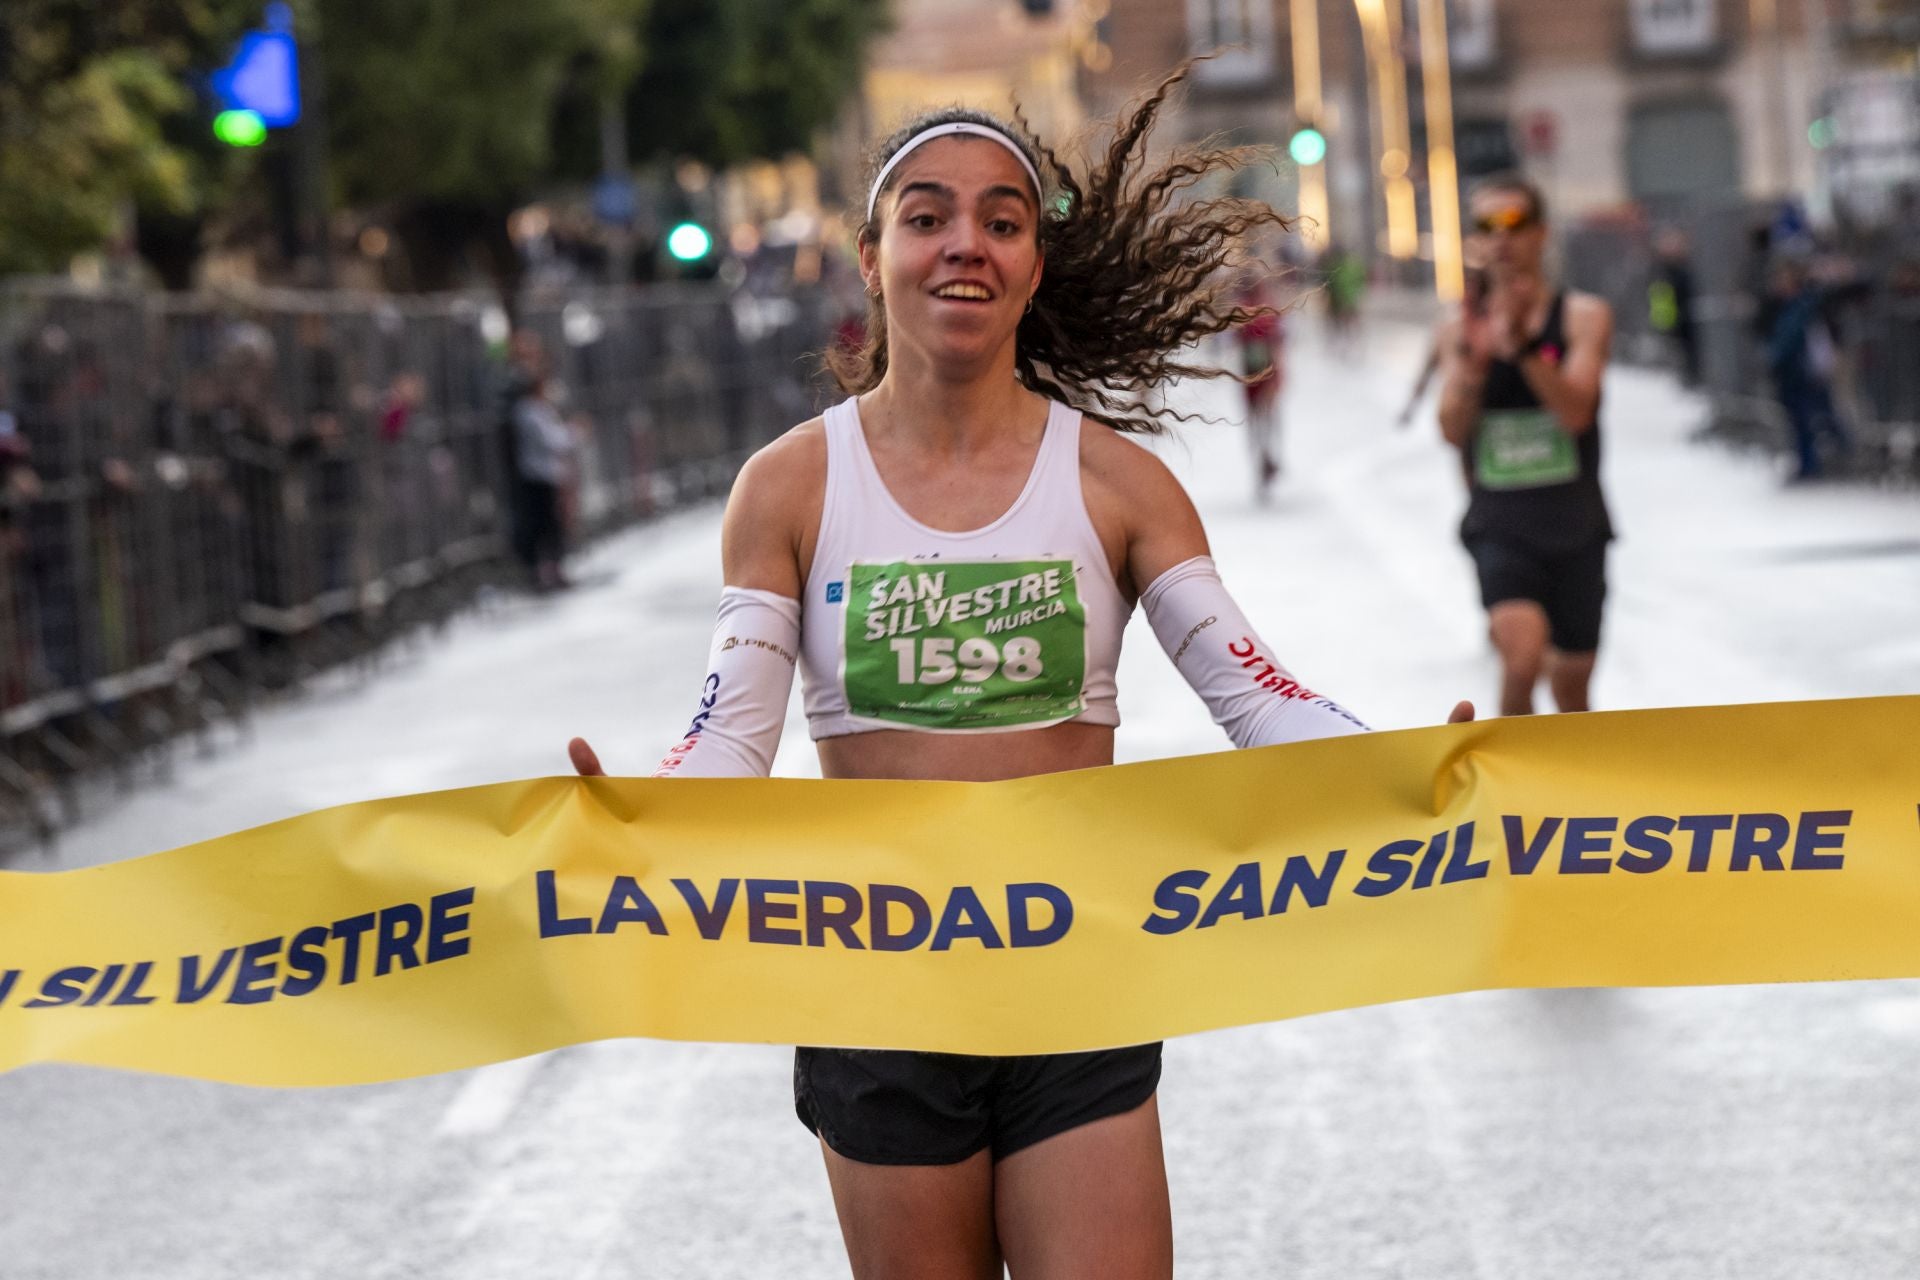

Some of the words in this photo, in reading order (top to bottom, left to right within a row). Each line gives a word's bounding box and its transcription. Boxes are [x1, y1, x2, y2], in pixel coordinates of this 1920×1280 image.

[864, 568, 1063, 641] SILVESTRE
[868, 570, 946, 610] SAN
[984, 599, 1067, 635] MURCIA
[889, 636, 1044, 686] 1598
[22, 887, 475, 1008] SILVESTRE
[1141, 849, 1347, 936] SAN
[1352, 809, 1853, 898] SILVESTRE
